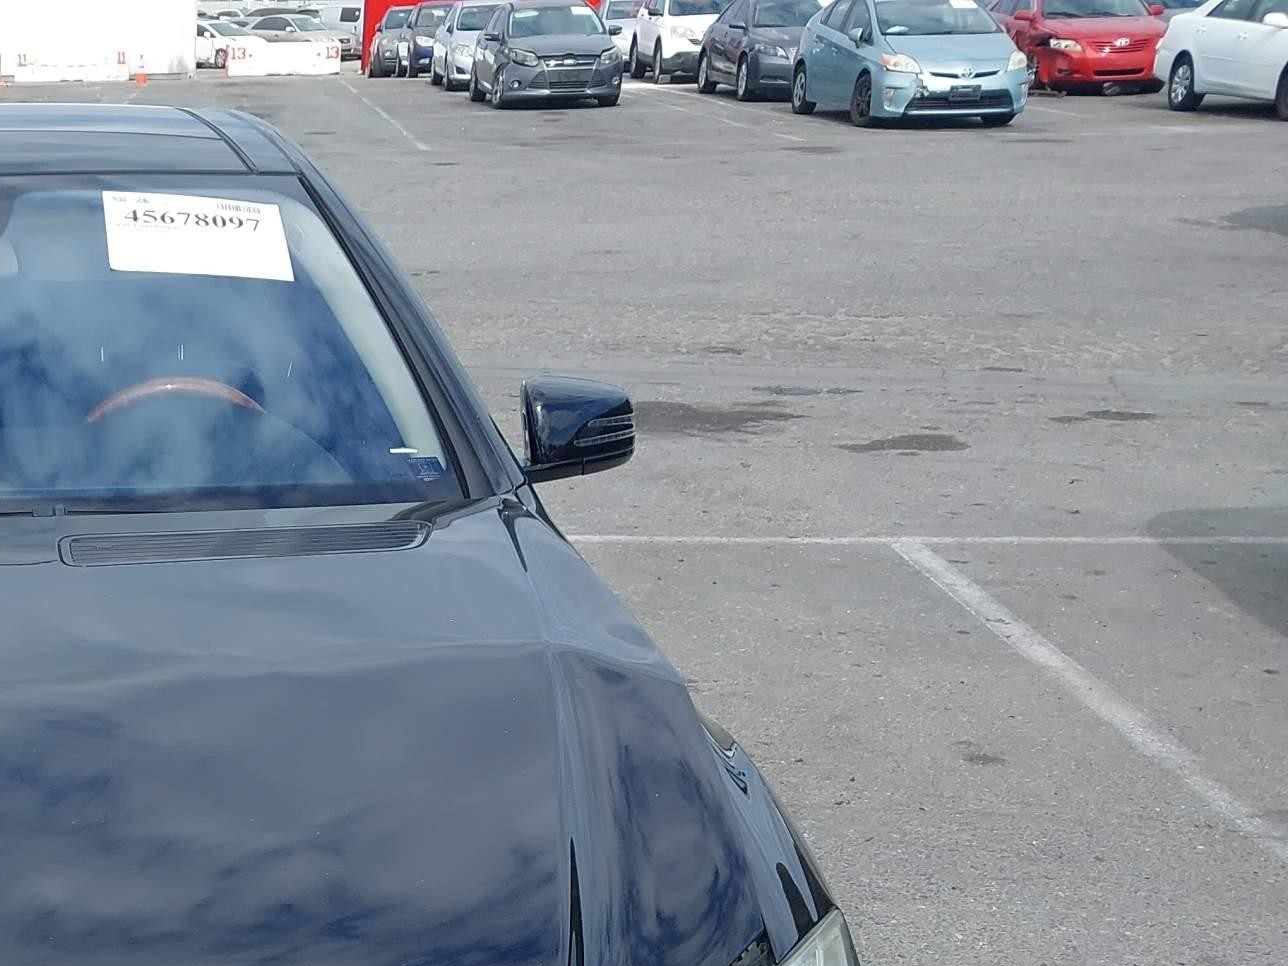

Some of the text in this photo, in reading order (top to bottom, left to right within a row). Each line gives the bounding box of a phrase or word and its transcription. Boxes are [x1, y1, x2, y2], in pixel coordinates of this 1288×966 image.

[117, 51, 127, 65] 11
[230, 47, 246, 60] 13
[325, 46, 339, 59] 13
[17, 54, 28, 67] 11
[123, 208, 261, 232] 45678097
